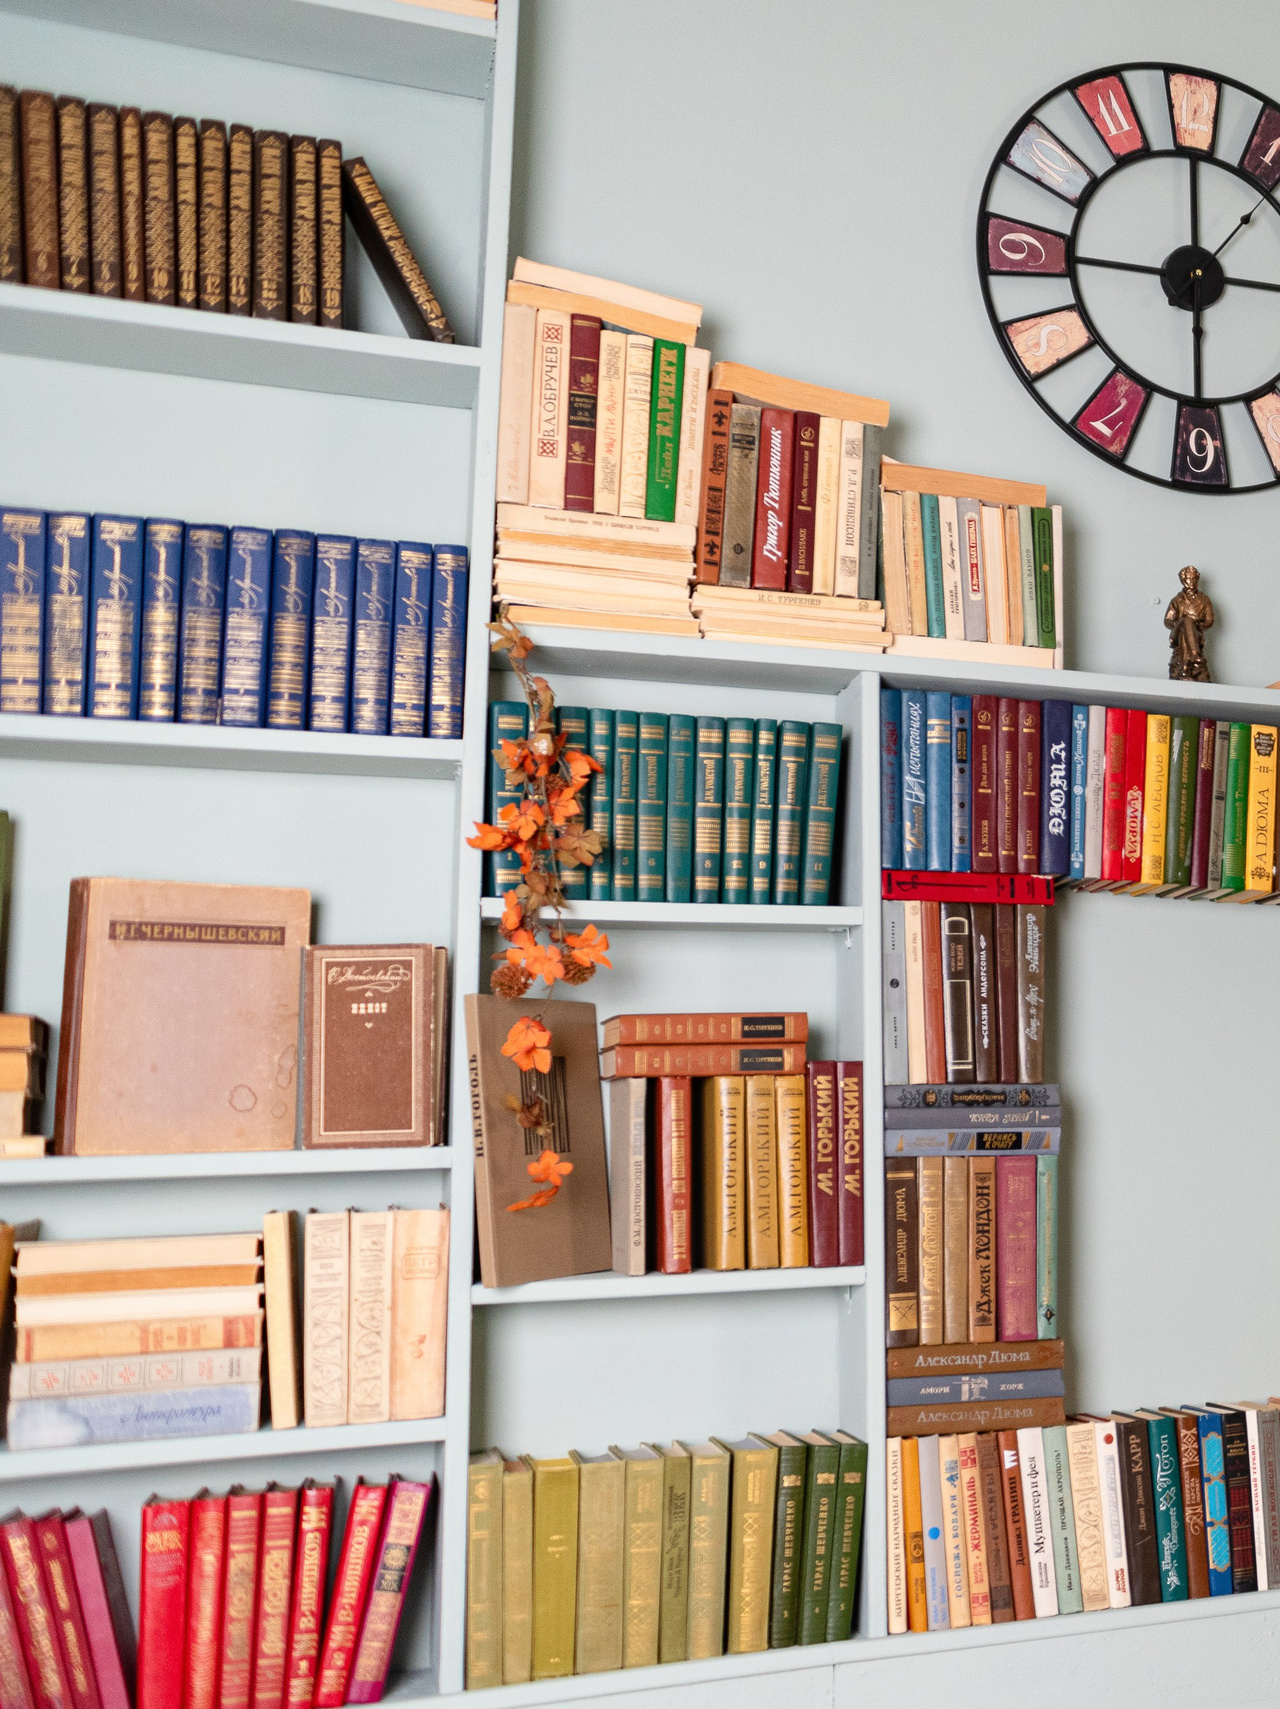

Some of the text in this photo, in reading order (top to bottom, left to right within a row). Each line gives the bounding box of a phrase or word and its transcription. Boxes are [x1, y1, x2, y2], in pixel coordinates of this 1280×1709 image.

[1097, 88, 1133, 137] 11
[1180, 90, 1210, 133] 12
[1030, 137, 1073, 188] 10
[999, 234, 1045, 266] 9
[1025, 325, 1069, 357] 8
[656, 347, 677, 438] КАРНЕГИ
[1089, 409, 1123, 437] 7
[1187, 427, 1214, 473] 6
[763, 427, 783, 562] Григор Тютюнник
[908, 702, 921, 774] испытаниях
[1048, 741, 1068, 837] ДЮМА
[1152, 754, 1164, 813] ЛЕСКОВ
[1256, 788, 1269, 845] ДЮМА
[704, 859, 712, 868] 8
[732, 860, 743, 868] 12
[759, 861, 766, 870] 9
[956, 944, 964, 970] ТЕЗЕЙ
[980, 1004, 988, 1035] СКАЗКИ
[813, 1075, 833, 1196] М. ГОРЬКИЙ
[840, 1077, 860, 1197] М. ГОРЬКИЙ
[983, 1133, 1016, 1142] ВЕРНИСЬ
[895, 1188, 907, 1282] АЛЕКСАНДР ДЮМА
[975, 1185, 992, 1315] Джек ЛОНДОН
[915, 1351, 1030, 1369] Александр Дюма
[917, 1407, 1034, 1424] Александр Дюма
[920, 1386, 950, 1394] АМОРИ
[1129, 1435, 1147, 1530] Джон Диксон КАРР
[1155, 1435, 1174, 1491] Потоп
[892, 1494, 900, 1550] НАРОДНЫЕ
[967, 1476, 981, 1552] ЖЕРМИНАЛЬ
[1009, 1476, 1026, 1566] Даниил ГРАНИН
[1027, 1456, 1046, 1554] Мушкетер и фея
[782, 1499, 795, 1593] ТАРАС ШЕВЧЕНКО
[814, 1497, 829, 1591] ТАРАС ШЕВЧЕНКО
[840, 1495, 855, 1588] ТАРАС ШЕВЧЕНКО
[950, 1494, 962, 1598] ГОСПОЖА БОВАРИ
